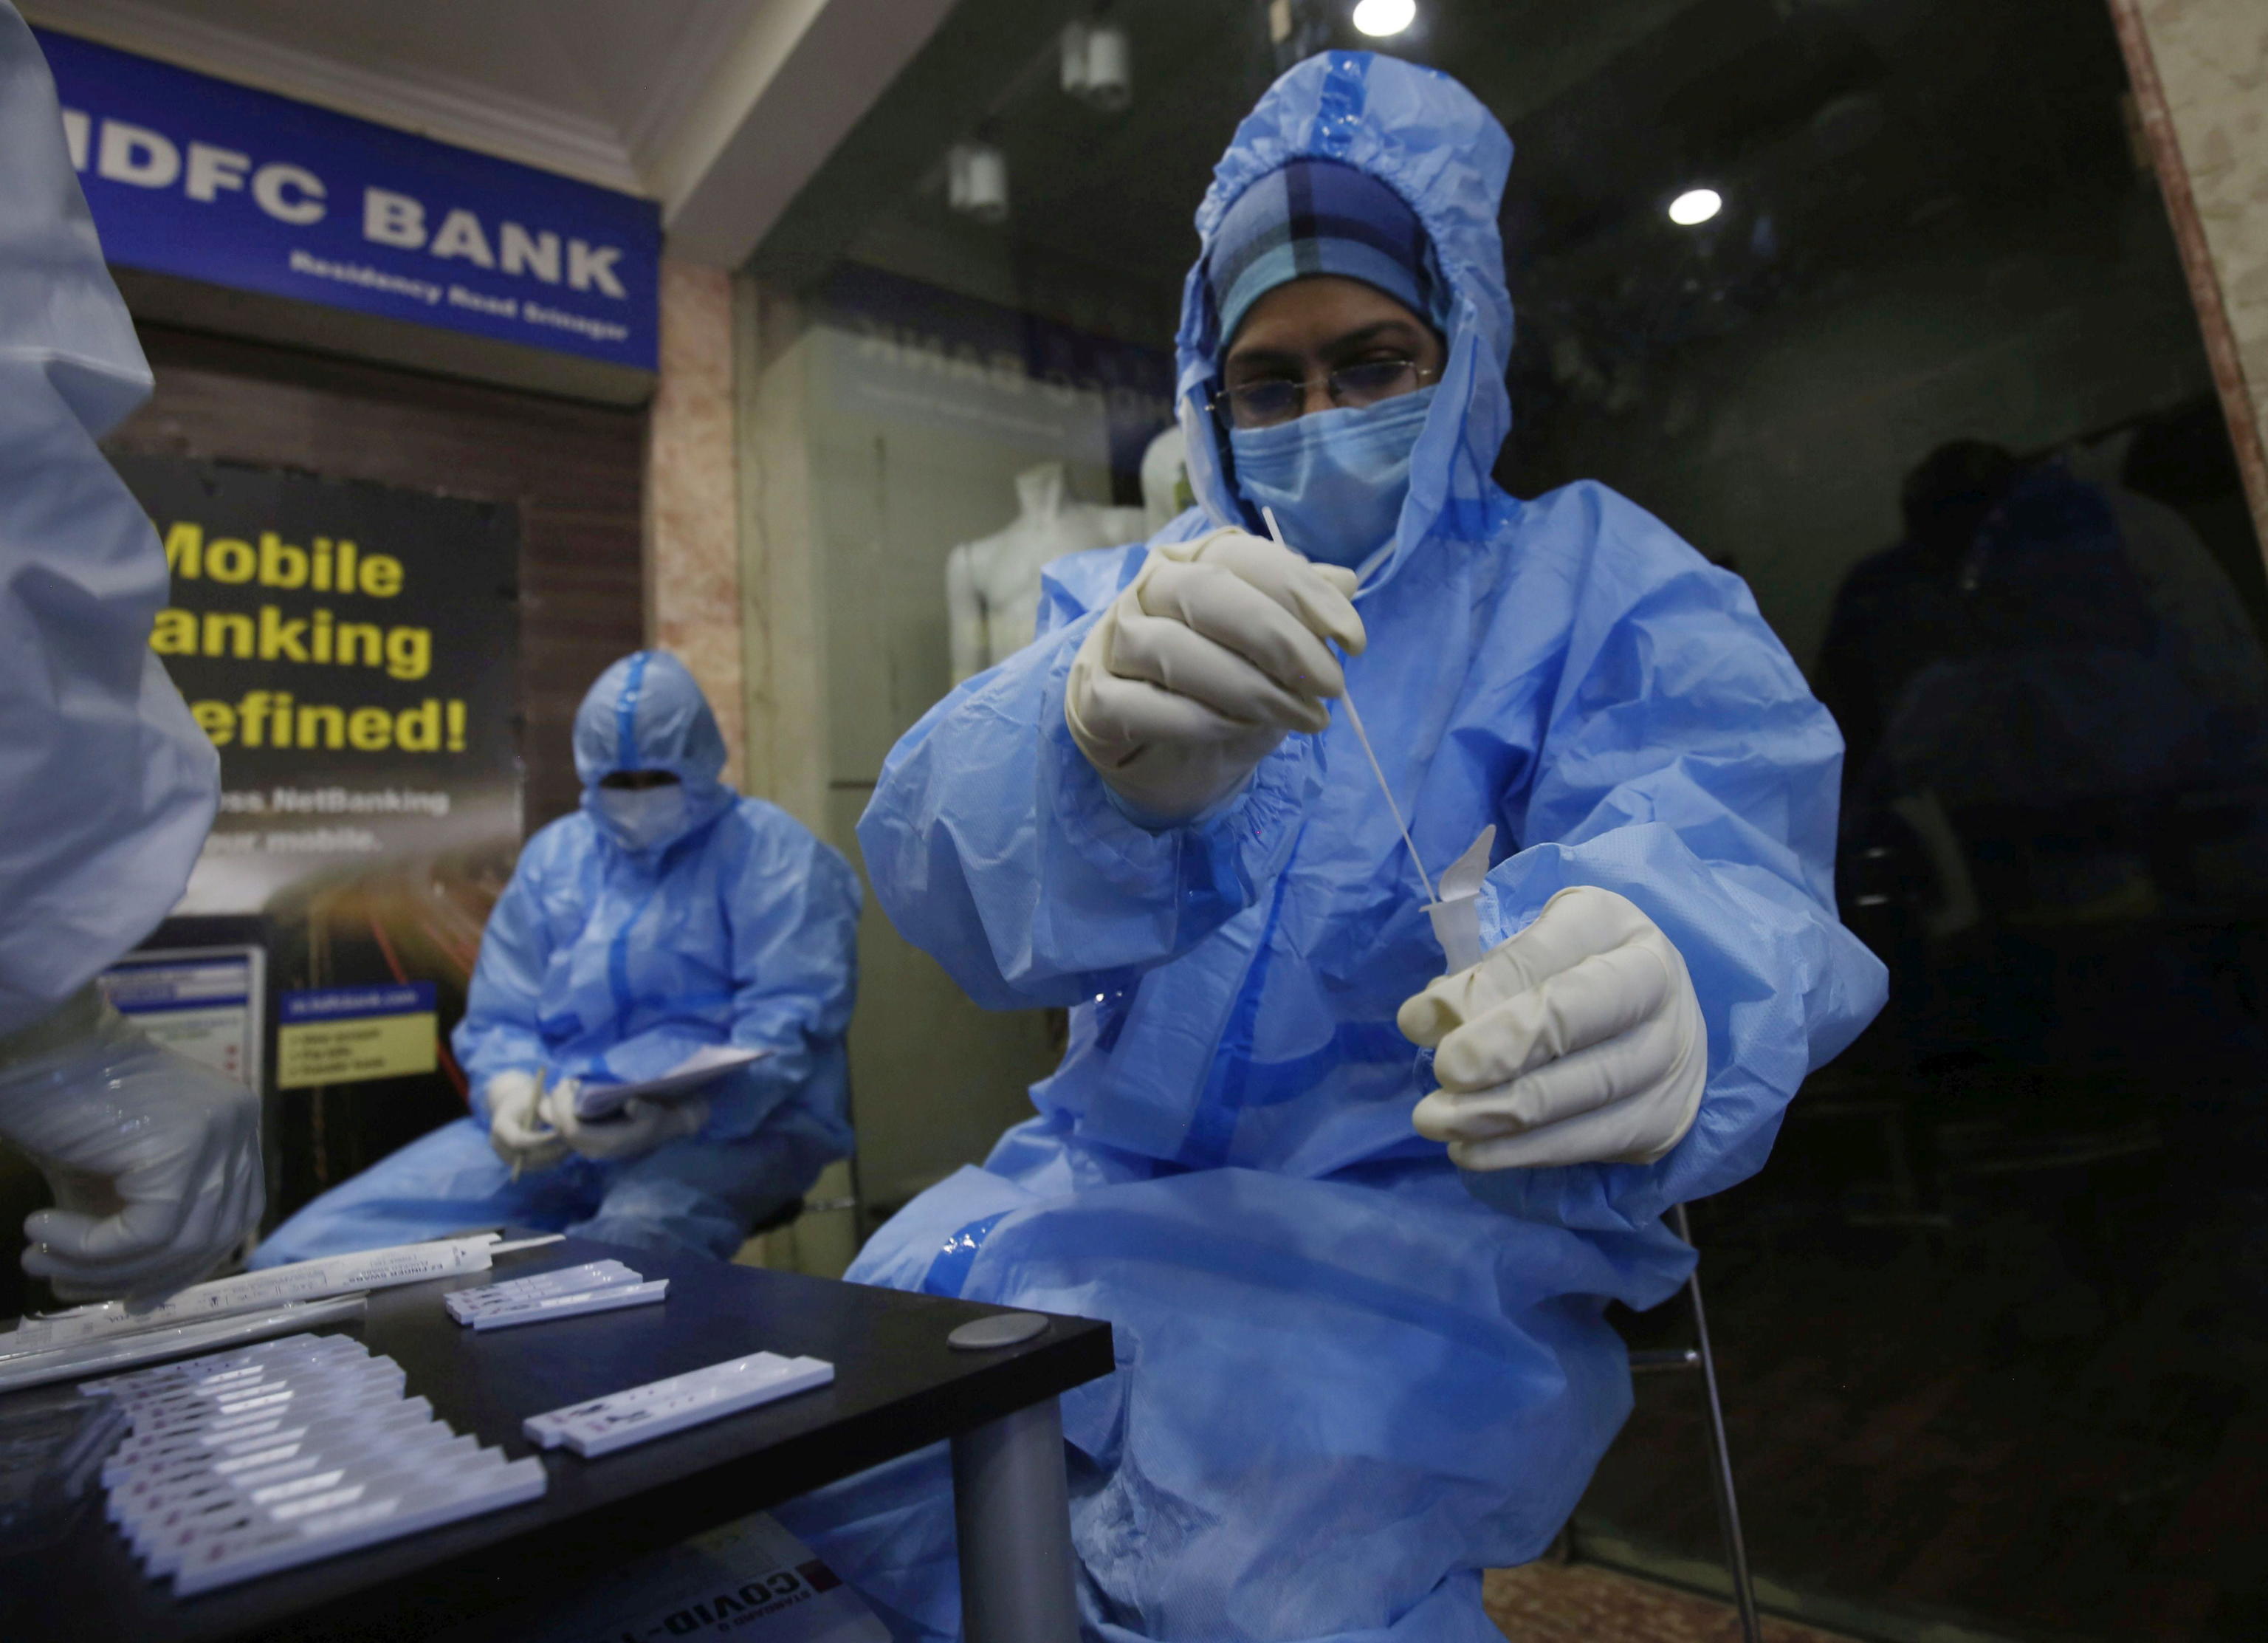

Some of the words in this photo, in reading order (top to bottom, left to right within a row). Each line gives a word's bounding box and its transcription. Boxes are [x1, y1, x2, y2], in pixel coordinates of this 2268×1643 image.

[362, 185, 628, 298] BANK
[289, 249, 441, 305] Residency
[447, 284, 518, 318] Road
[523, 301, 629, 341] Srinagar
[148, 606, 432, 681] anking
[185, 690, 467, 752] efined!
[273, 786, 450, 816] NetBanking
